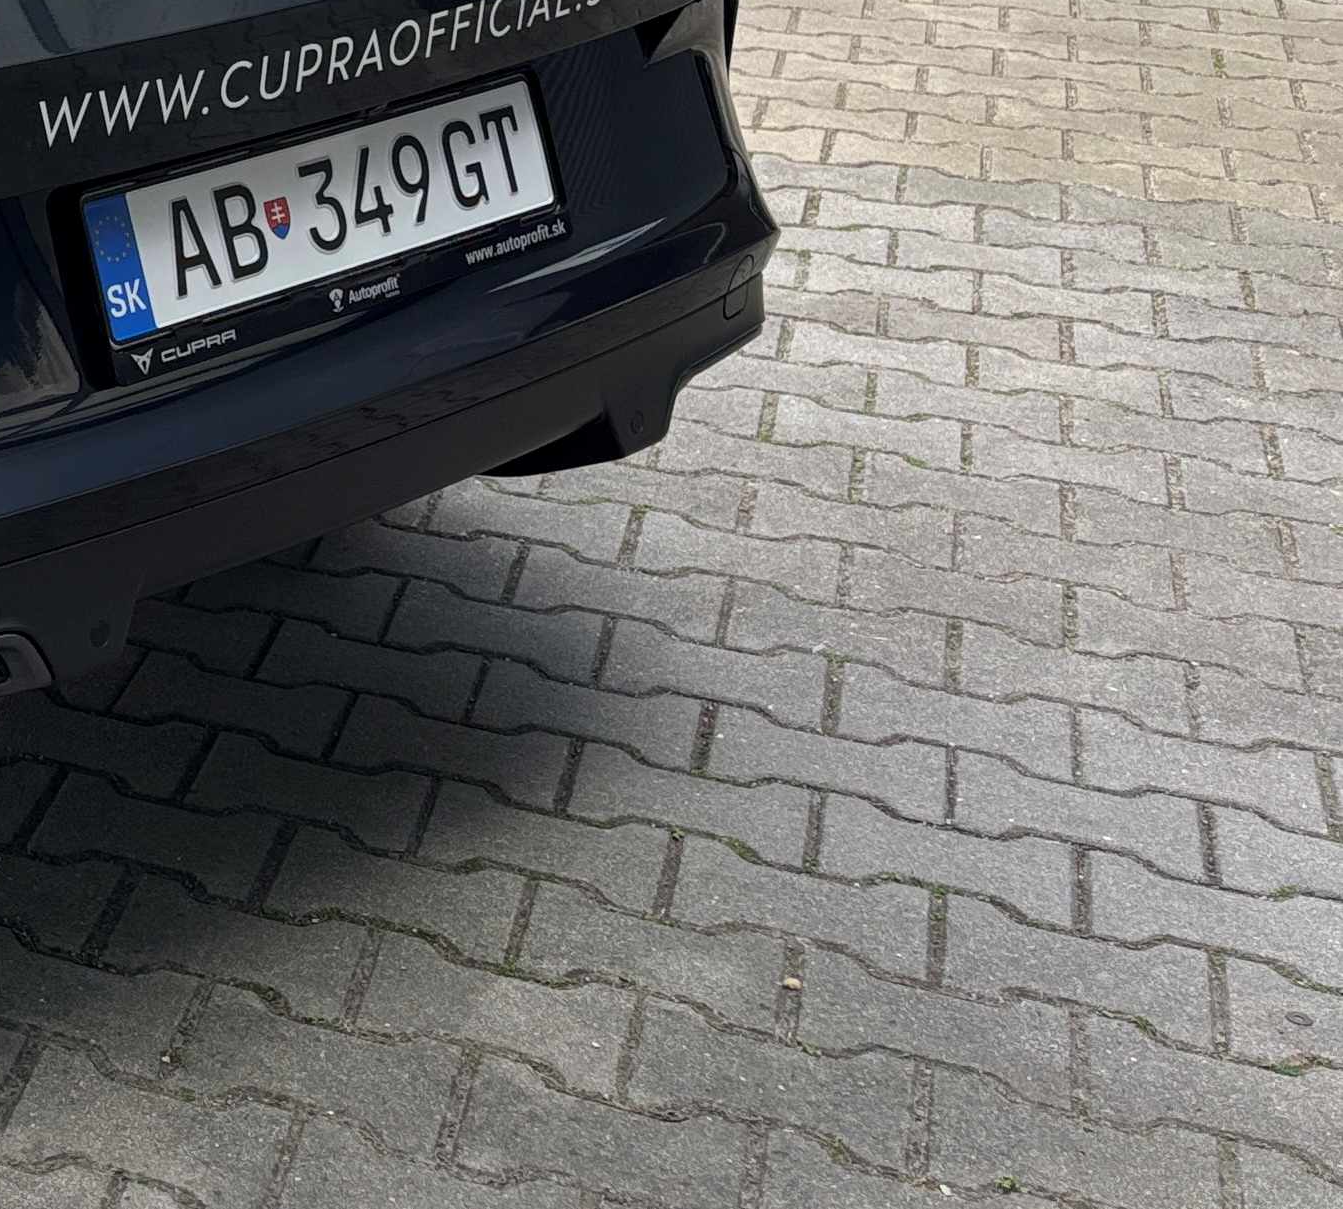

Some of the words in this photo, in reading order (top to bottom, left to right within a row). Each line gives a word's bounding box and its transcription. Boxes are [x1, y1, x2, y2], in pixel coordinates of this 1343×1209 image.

[170, 183, 269, 299] AB
[465, 218, 567, 266] www.autoprofit.sk
[106, 278, 147, 319] SK
[348, 276, 400, 305] Autoprofit
[161, 329, 237, 363] CUPRA
